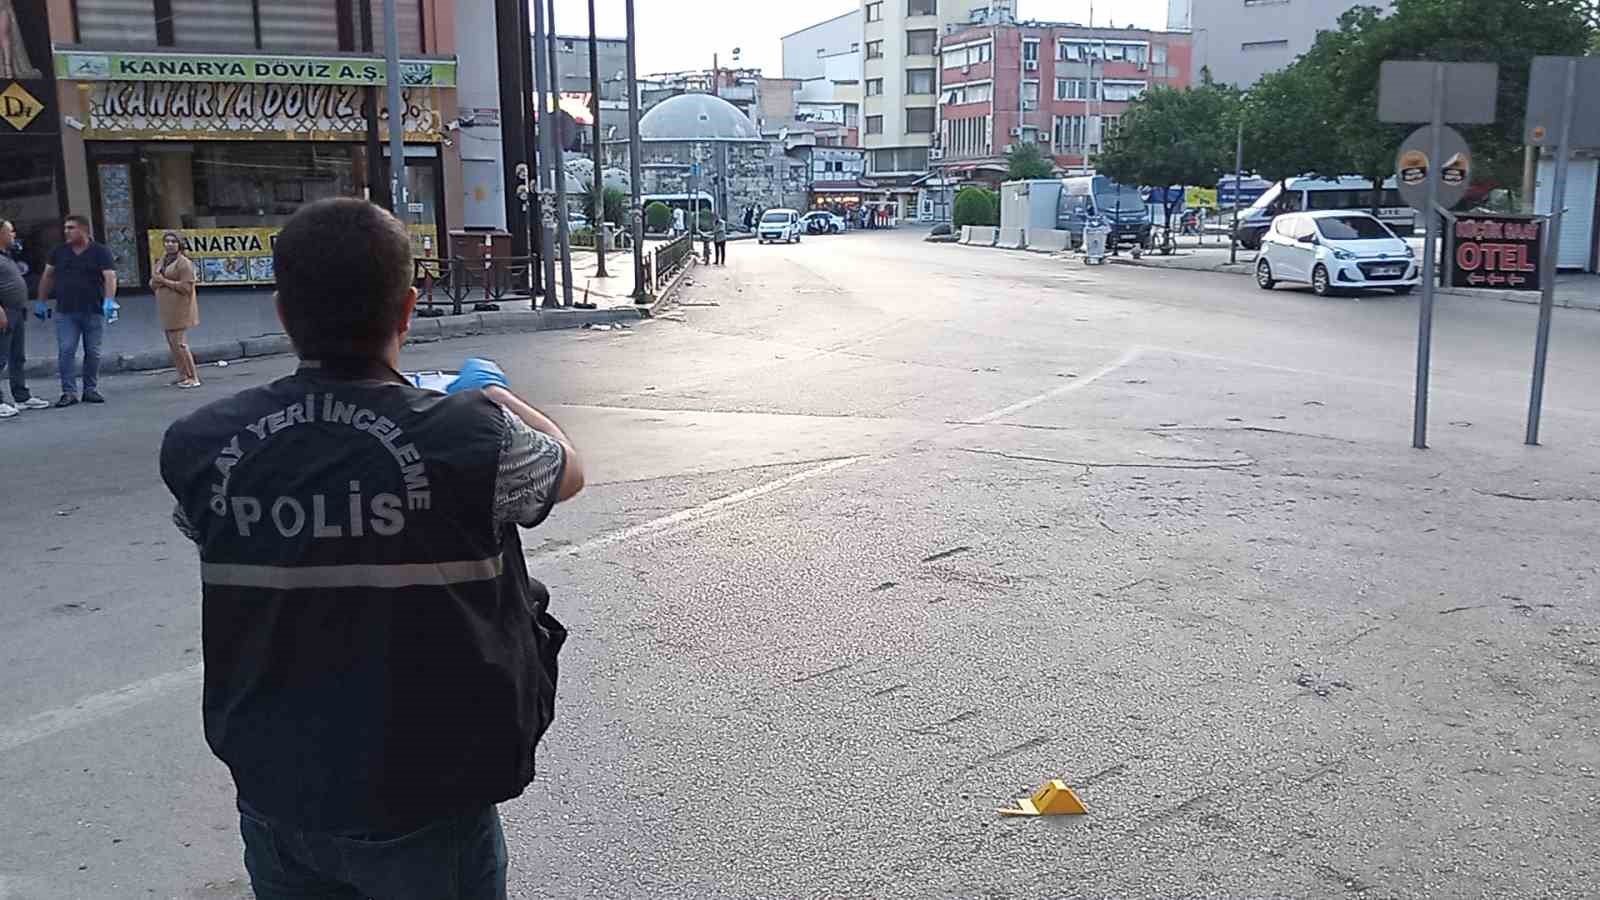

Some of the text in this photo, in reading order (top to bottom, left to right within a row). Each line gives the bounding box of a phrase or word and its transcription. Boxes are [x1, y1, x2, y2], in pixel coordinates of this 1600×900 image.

[120, 60, 385, 82] KANARYA DÖVİZ A.Ş.
[104, 82, 254, 117] KANARYA
[182, 235, 262, 252] ANARYA
[1456, 241, 1536, 271] OTEL
[210, 392, 431, 517] OLAY YERİ İNCELEME
[231, 480, 405, 538] POLİS
